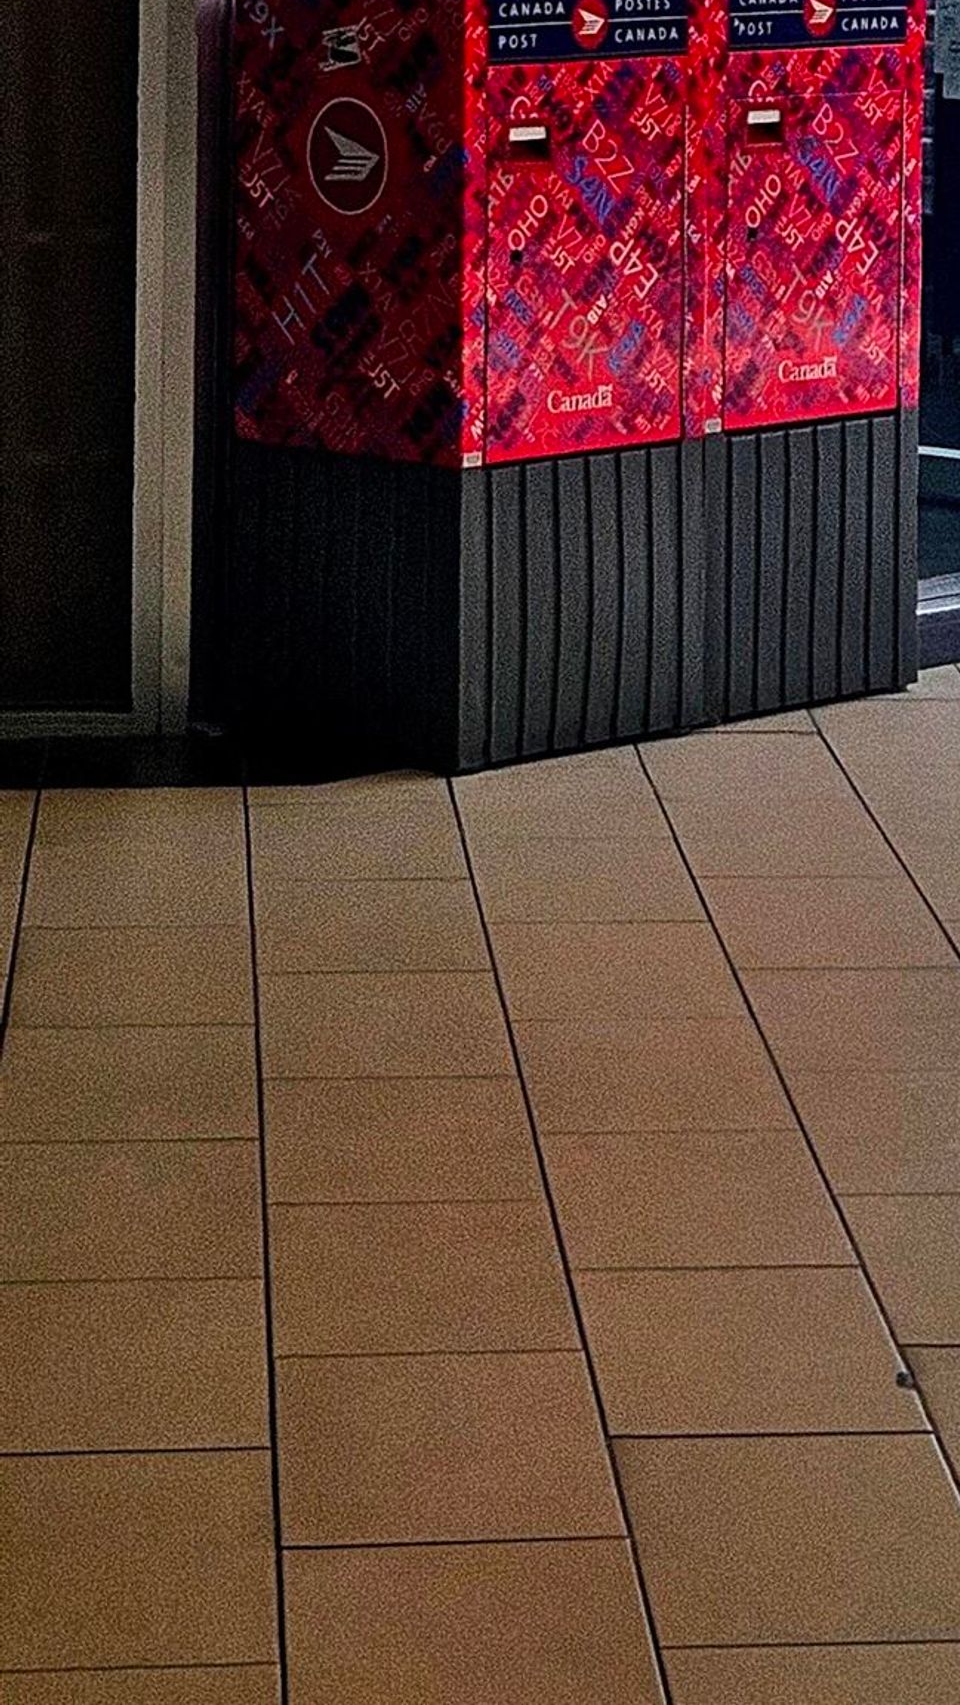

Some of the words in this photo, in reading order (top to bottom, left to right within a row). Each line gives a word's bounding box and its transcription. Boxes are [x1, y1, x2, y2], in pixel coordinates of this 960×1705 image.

[498, 0, 566, 19] CANADA
[498, 33, 539, 51] POST
[614, 27, 679, 44] CANADA
[738, 19, 773, 36] POST
[841, 16, 899, 33] CANADA
[812, 103, 859, 175] B2Z
[582, 119, 635, 194] B2Z
[779, 356, 838, 382] Canada
[547, 384, 613, 413] Canada
